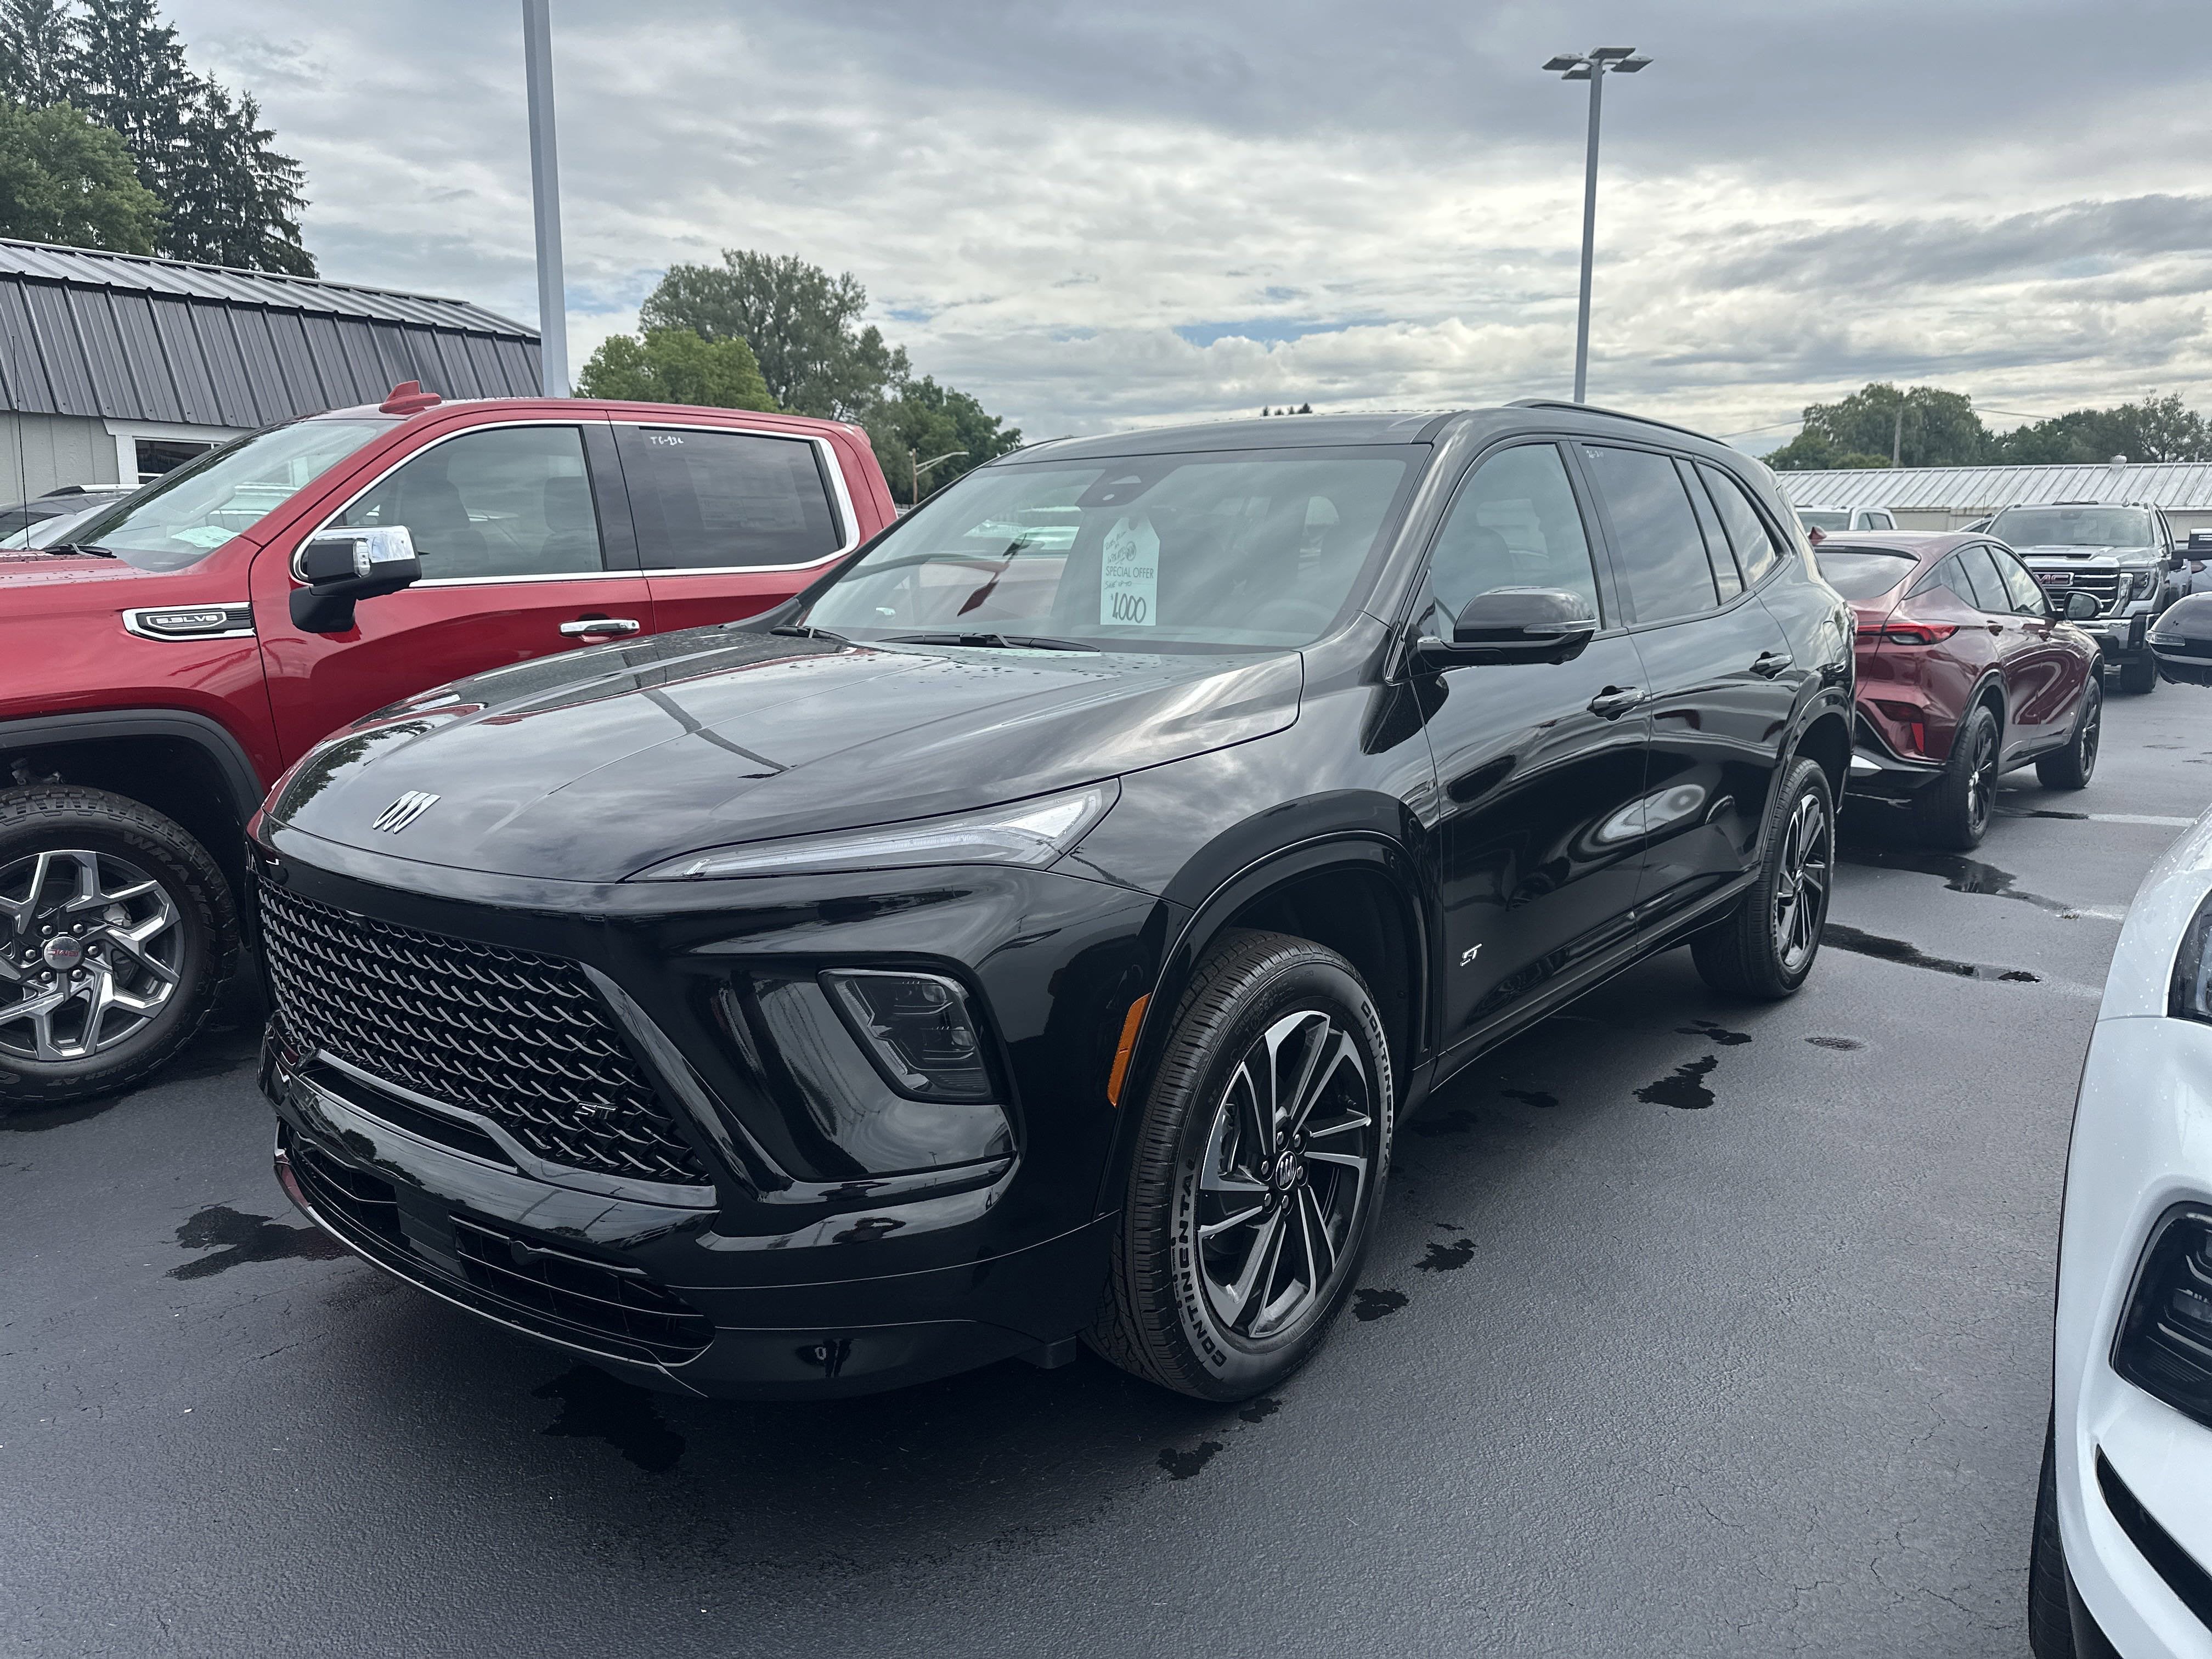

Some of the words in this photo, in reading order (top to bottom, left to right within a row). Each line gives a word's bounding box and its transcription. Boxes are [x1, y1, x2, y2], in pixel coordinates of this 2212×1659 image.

[1105, 566, 1131, 577] SPECIAL
[1132, 567, 1154, 578] OFFER
[2035, 574, 2069, 584] MC
[47, 948, 80, 957] GMC
[1361, 1000, 1392, 1195] CONTINENTAL
[574, 1101, 618, 1120] ST
[1179, 1147, 1227, 1368] CONTINENTAL
